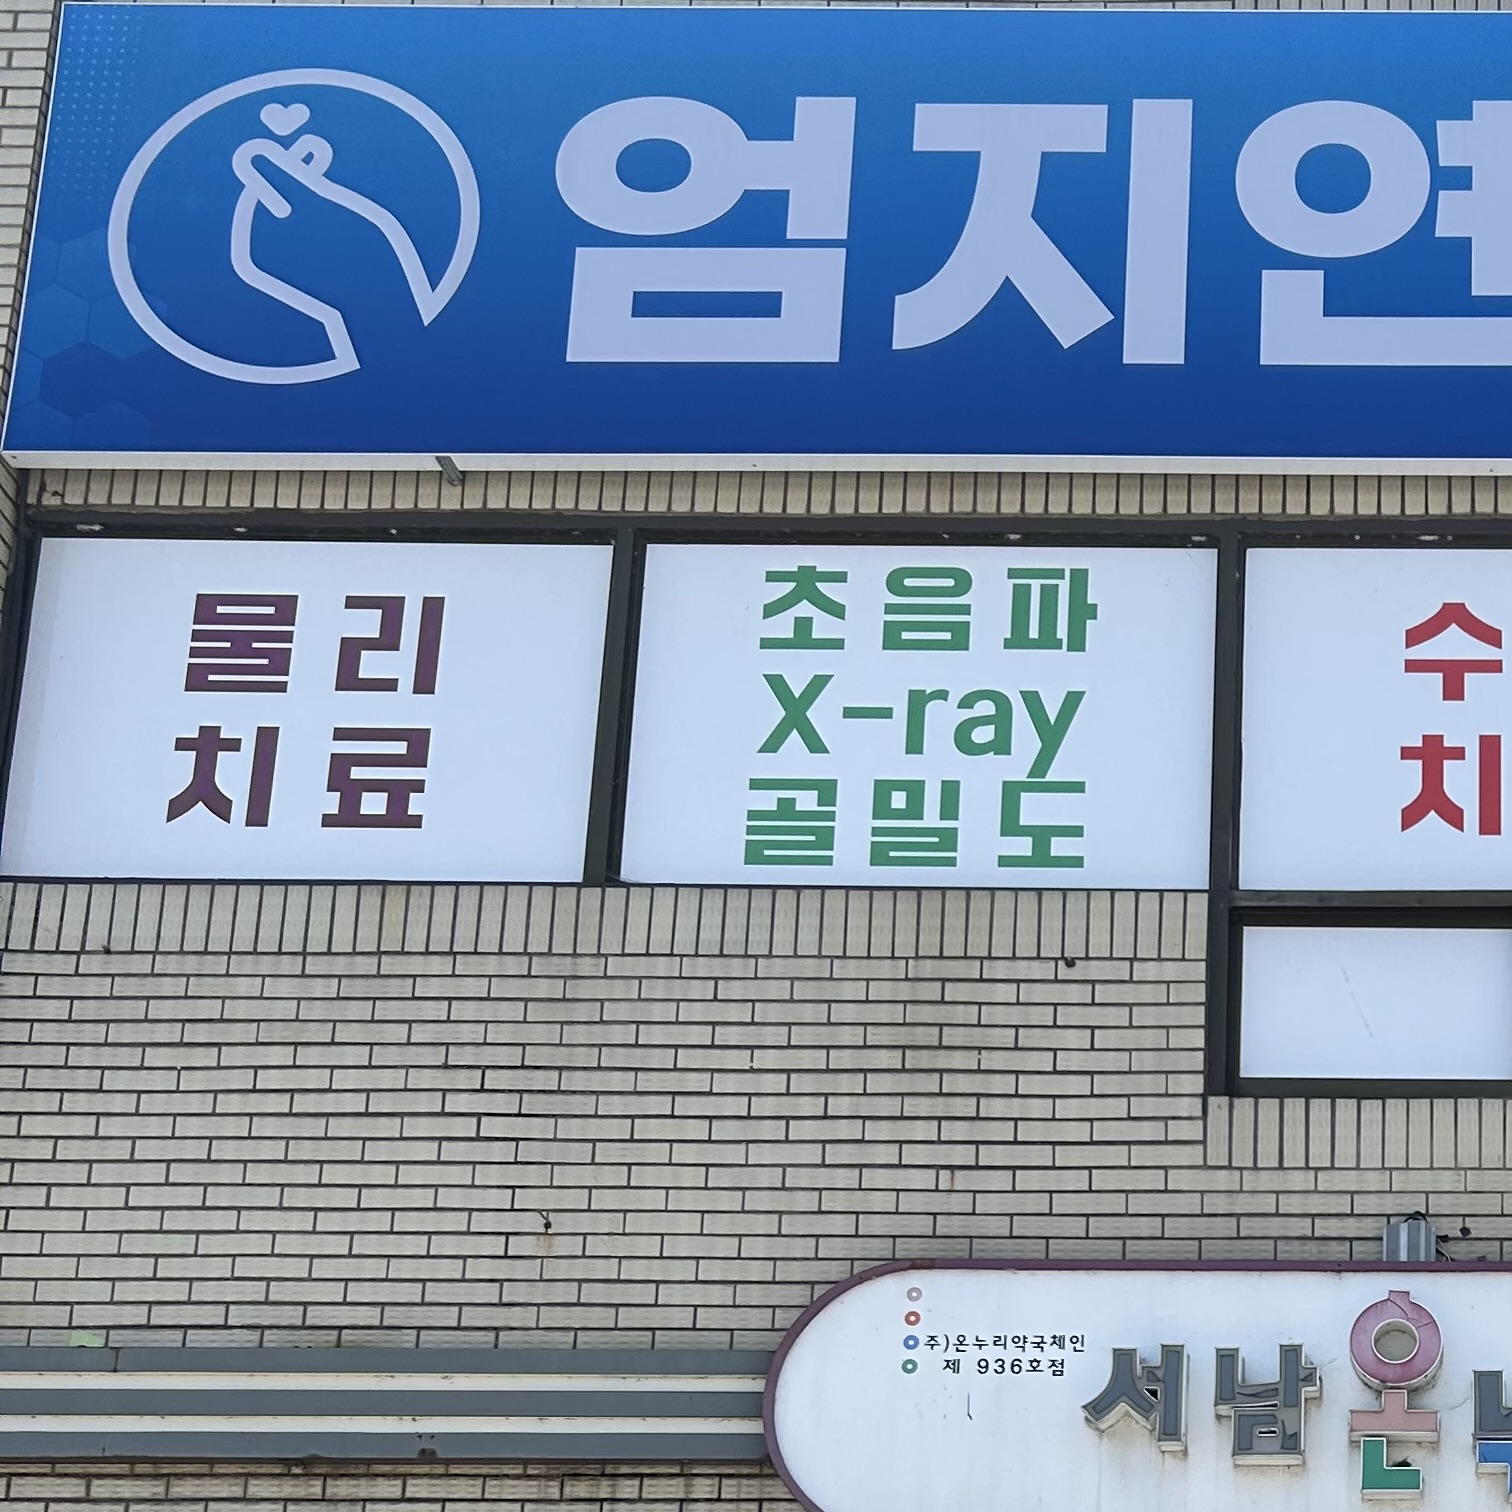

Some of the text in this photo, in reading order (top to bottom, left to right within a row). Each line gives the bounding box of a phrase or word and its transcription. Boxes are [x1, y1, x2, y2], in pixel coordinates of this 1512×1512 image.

[759, 674, 1086, 779] X-ray
[942, 1356, 1066, 1378] 제 936호점
